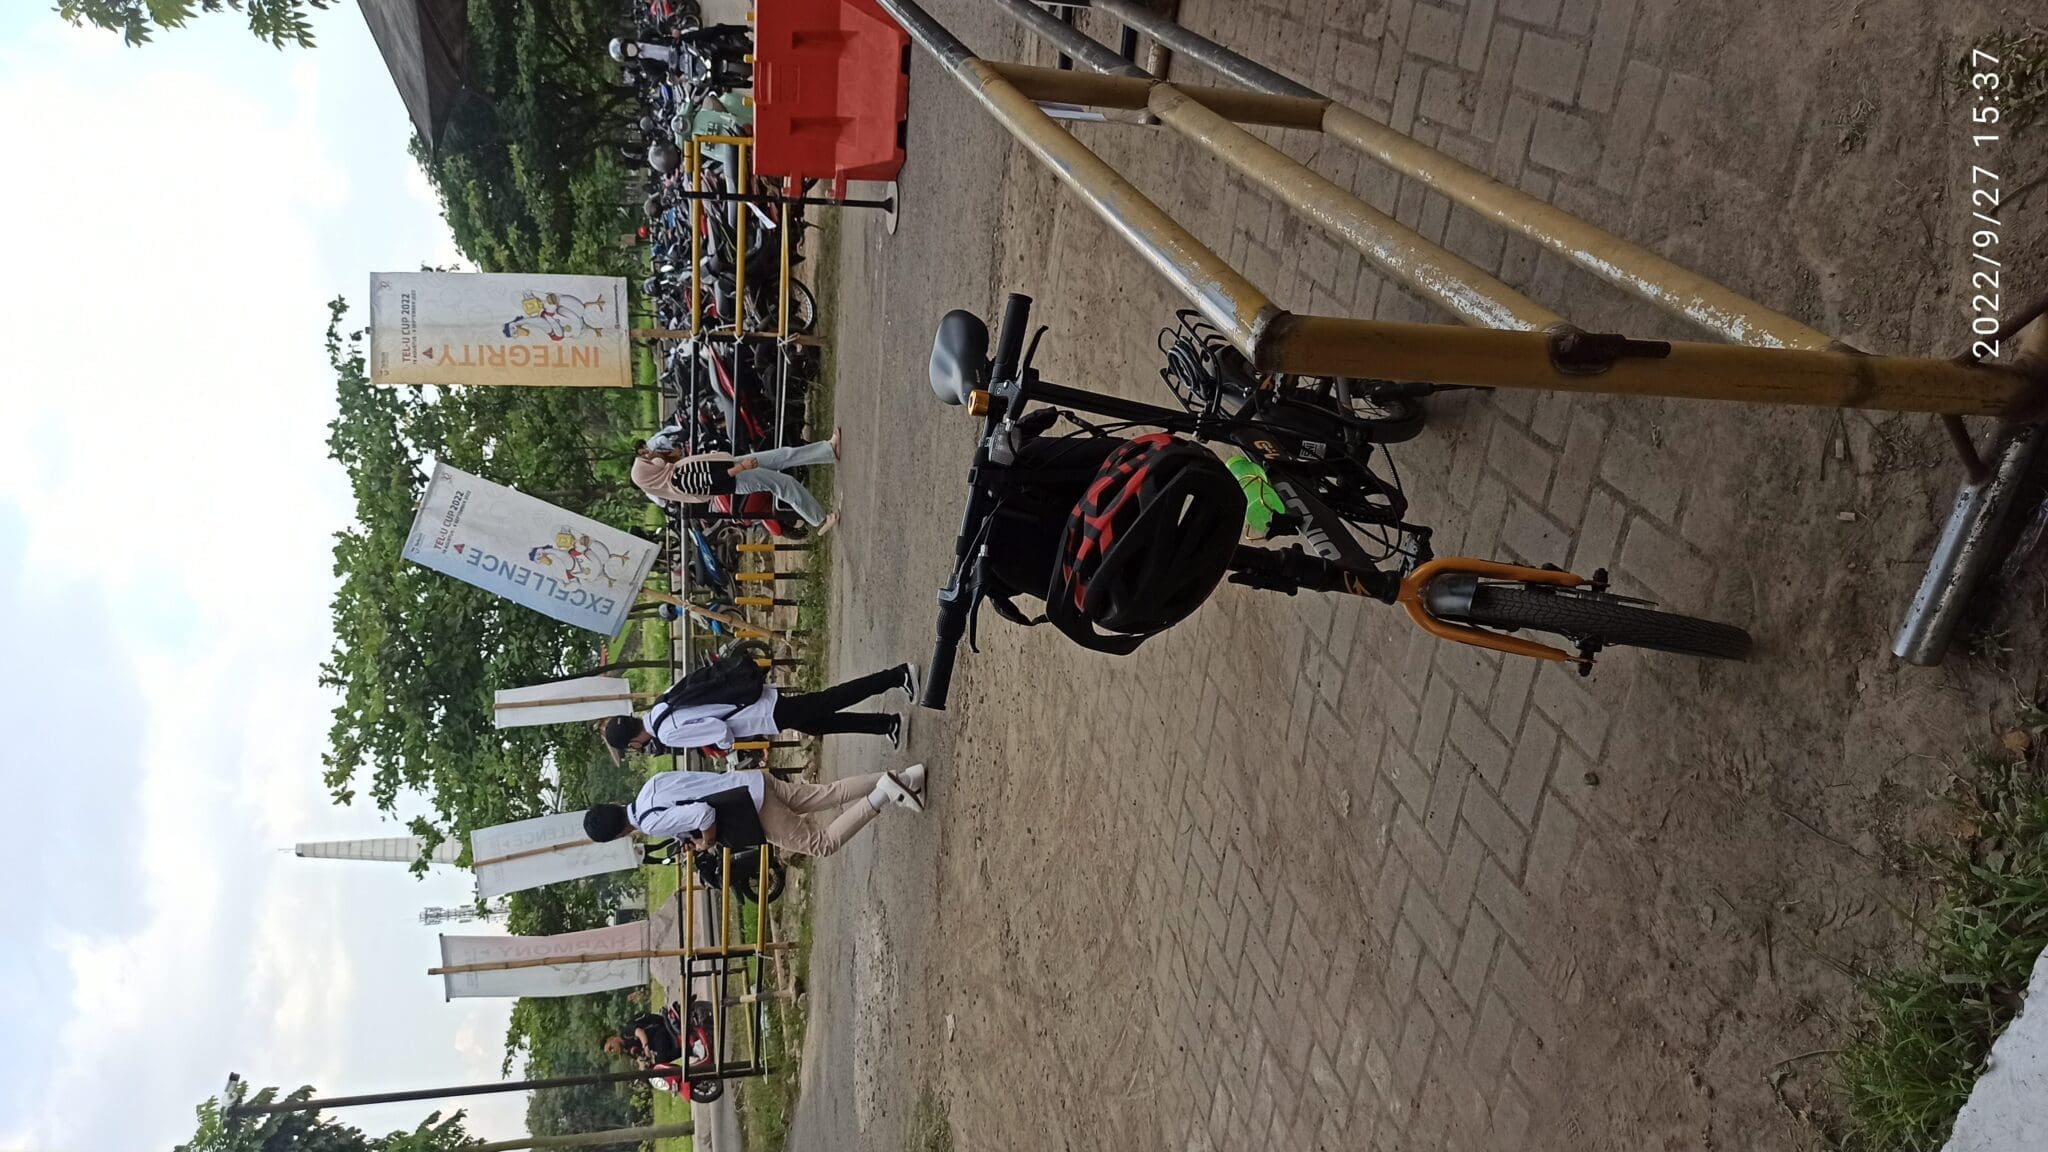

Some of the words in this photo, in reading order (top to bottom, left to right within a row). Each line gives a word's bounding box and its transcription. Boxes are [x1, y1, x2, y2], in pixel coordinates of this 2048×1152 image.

[401, 293, 410, 315] 2022
[401, 317, 410, 336] CUP
[402, 338, 410, 362] TEL-U
[443, 344, 600, 368] INTEGRITY
[434, 528, 450, 550] TEL-U
[442, 510, 455, 527] CUP
[450, 490, 464, 510] 2022
[466, 547, 616, 615] EXCELLENCE
